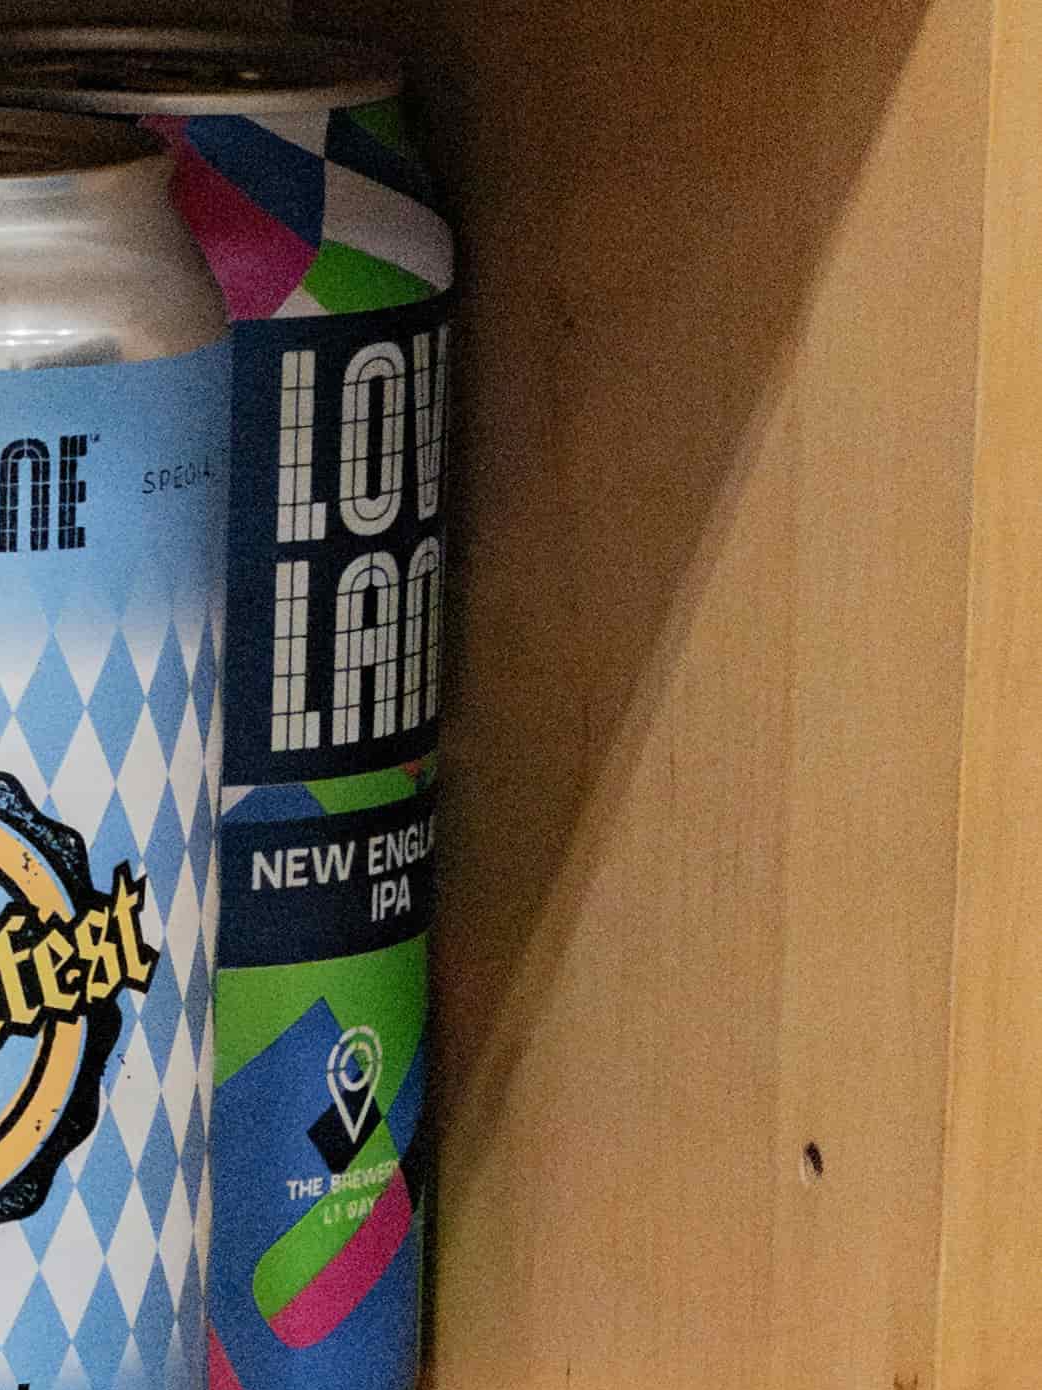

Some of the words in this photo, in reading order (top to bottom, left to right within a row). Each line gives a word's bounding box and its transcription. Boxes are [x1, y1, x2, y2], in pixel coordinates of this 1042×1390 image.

[251, 840, 356, 891] NEW
[370, 874, 411, 922] IPA
[286, 1176, 325, 1200] THE
